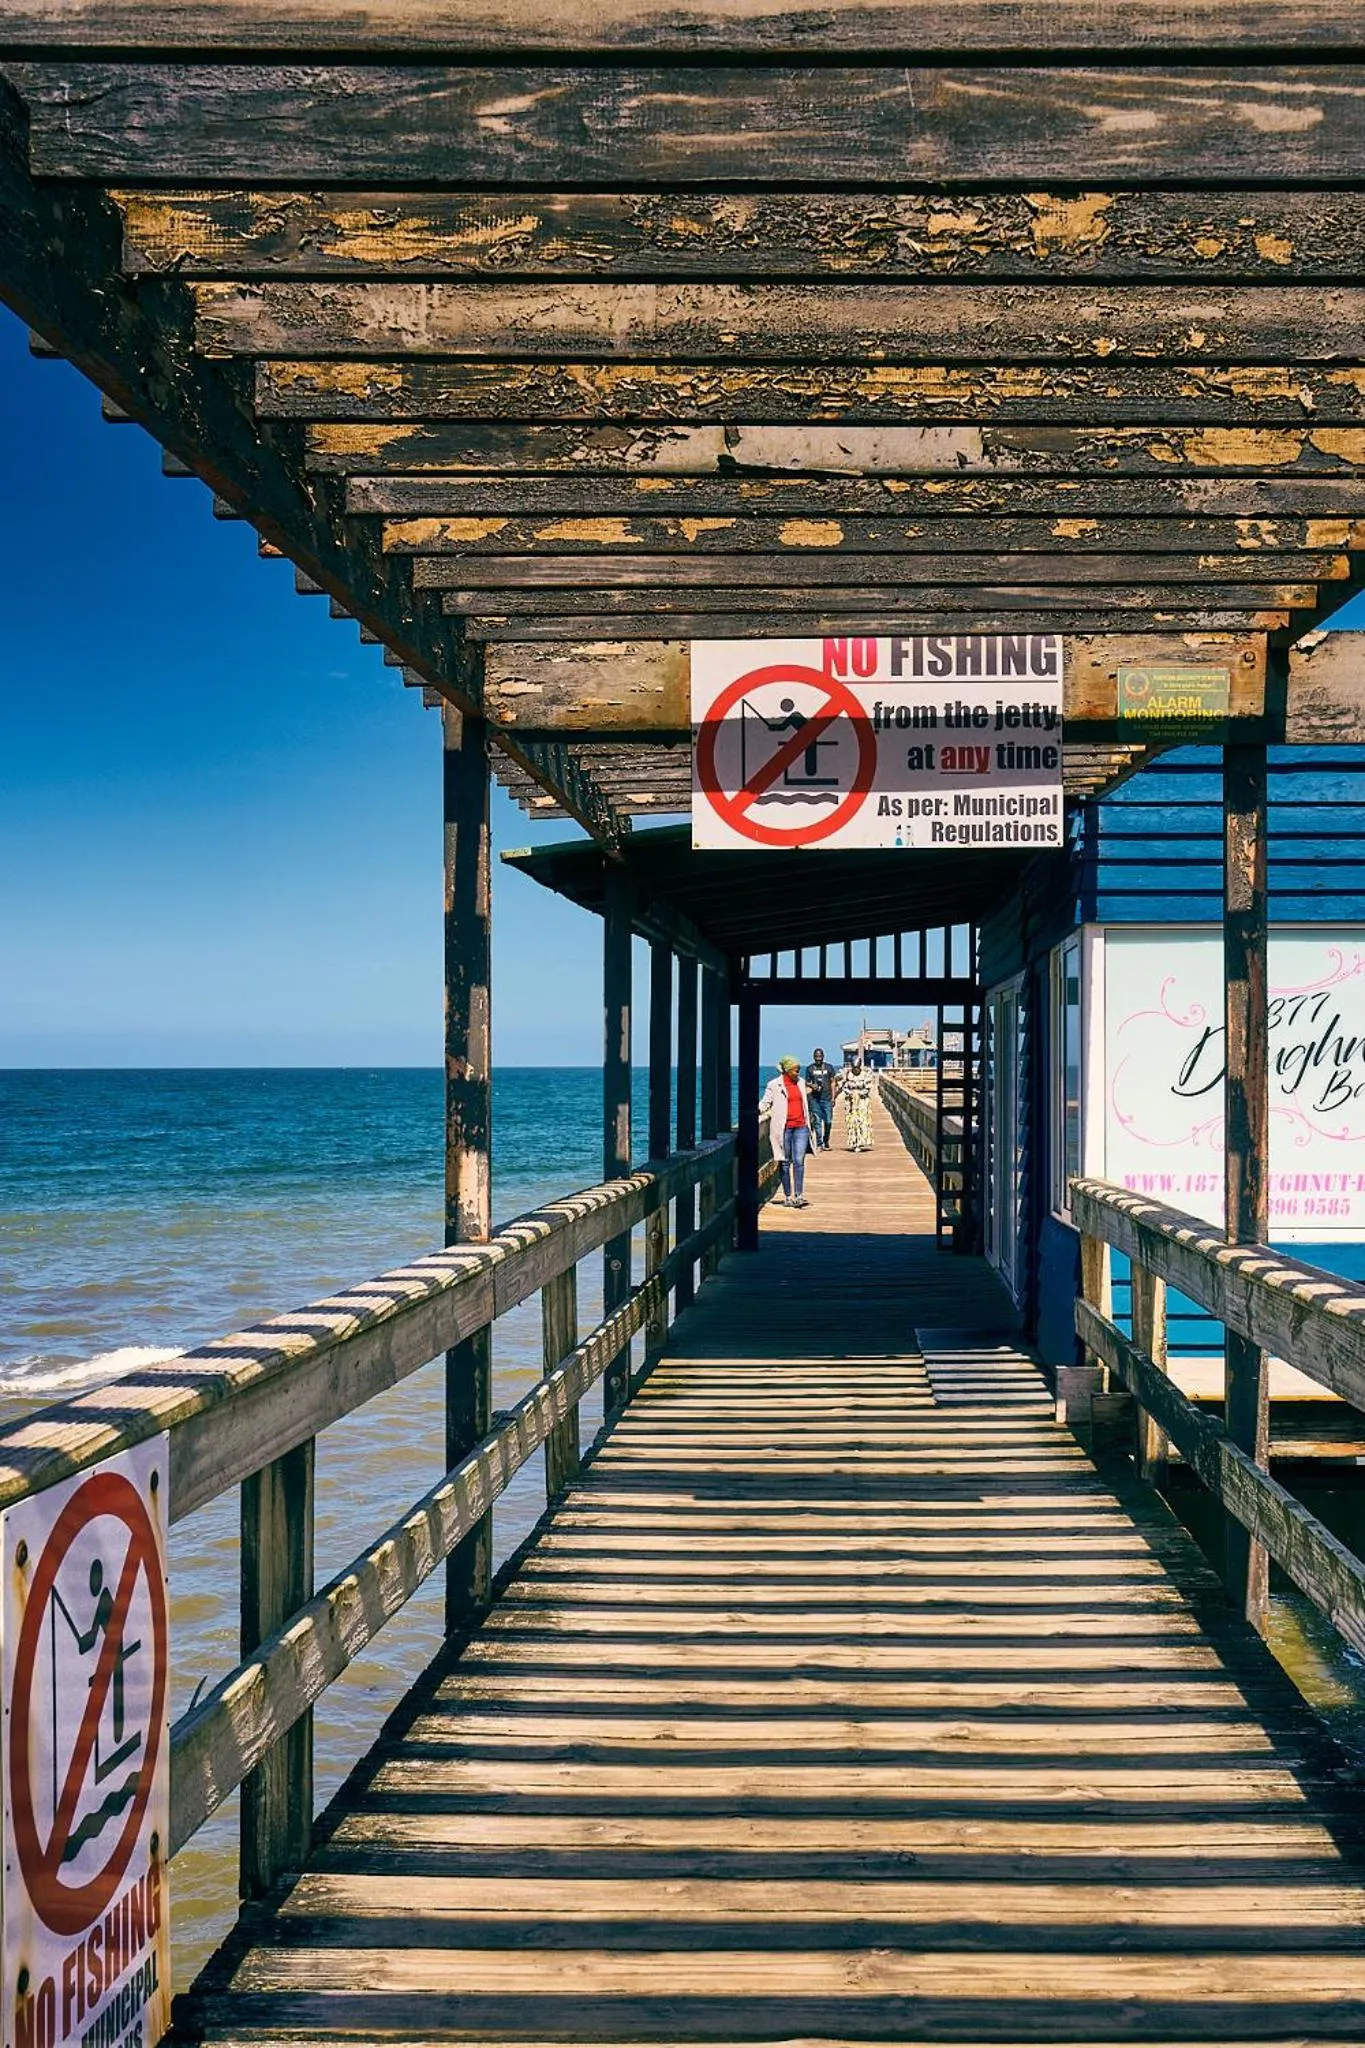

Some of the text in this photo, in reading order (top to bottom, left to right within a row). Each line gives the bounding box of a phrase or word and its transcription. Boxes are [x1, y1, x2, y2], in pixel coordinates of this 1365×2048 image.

[822, 635, 1057, 677] NO FISHING
[873, 701, 941, 729] from
[944, 701, 991, 728] the
[1124, 708, 1224, 722] MONITORING
[1147, 696, 1202, 709] ALARM
[907, 743, 1058, 773] at any time
[877, 794, 1058, 818] As per: Municipal
[931, 821, 1058, 843] Regulations
[1268, 992, 1331, 1029] 877
[1304, 1199, 1351, 1215] 9585
[15, 1864, 161, 2048] NO FISHING
